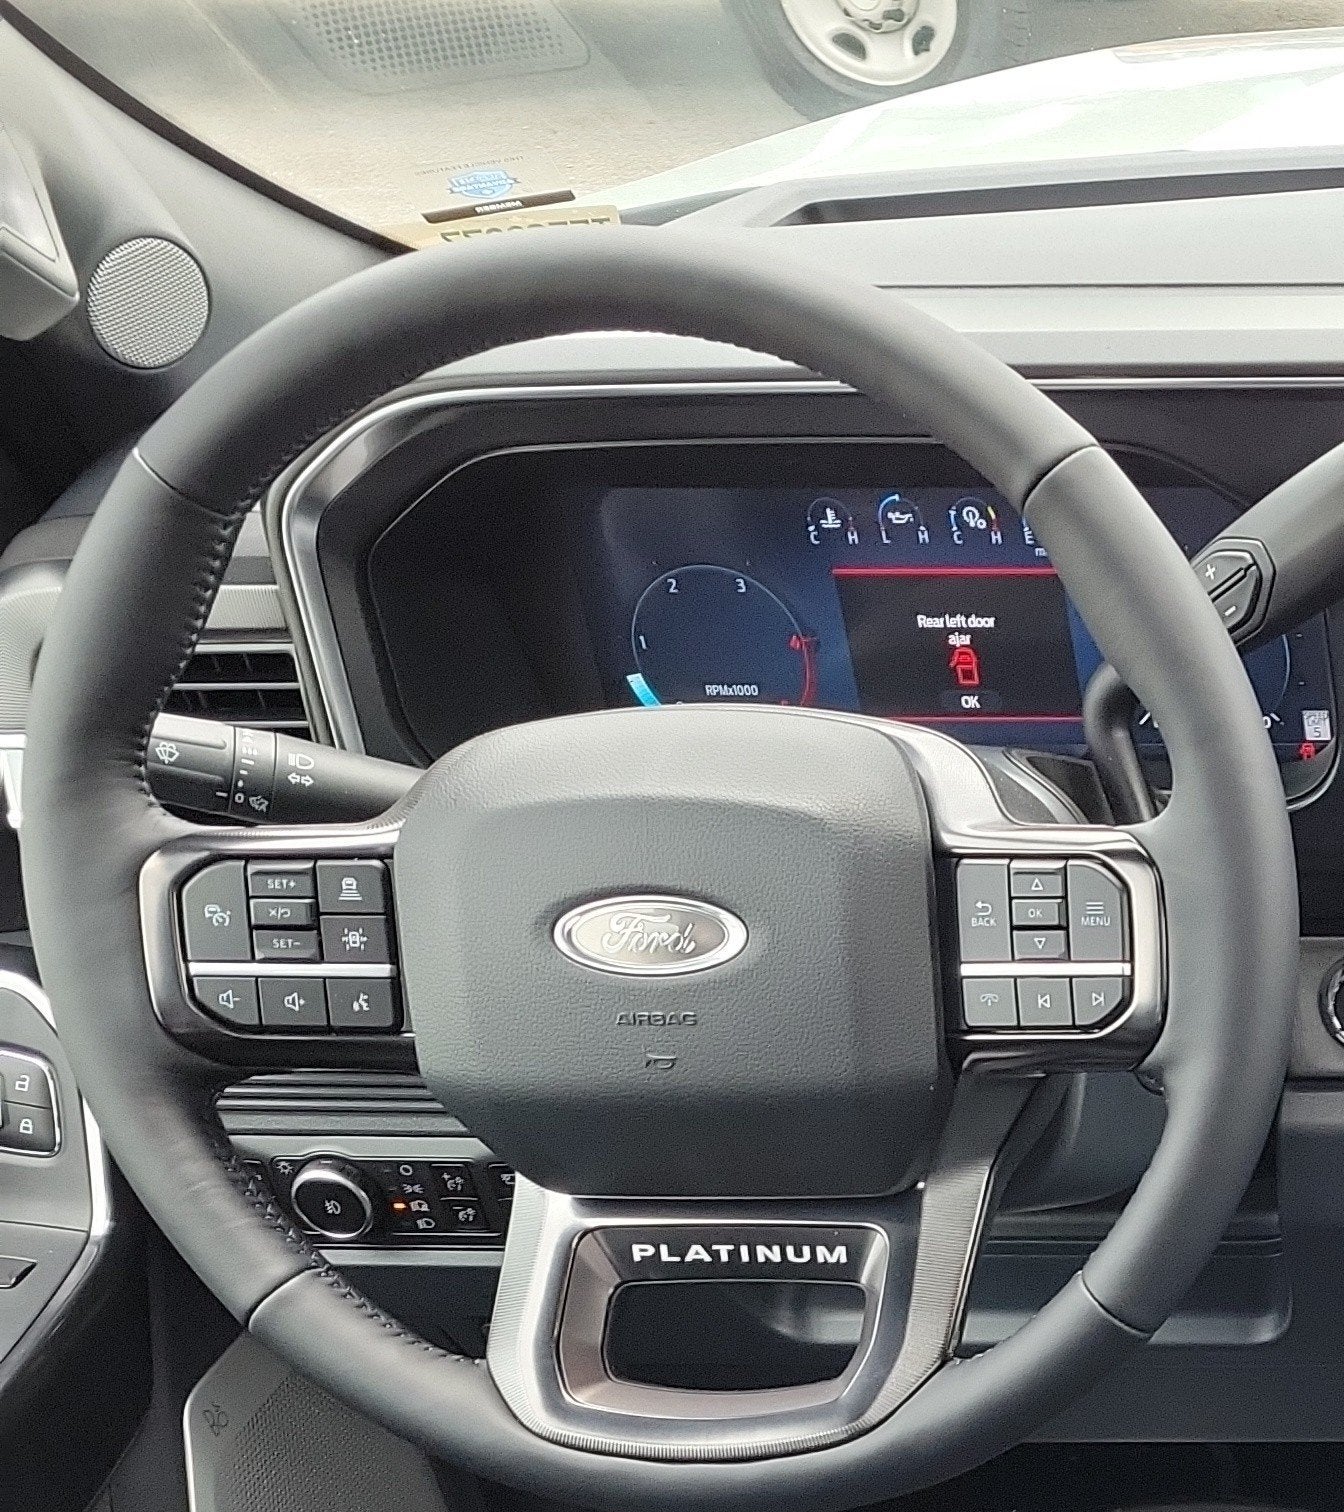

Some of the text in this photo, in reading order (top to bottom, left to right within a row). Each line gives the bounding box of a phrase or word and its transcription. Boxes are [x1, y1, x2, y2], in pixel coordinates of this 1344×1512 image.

[847, 531, 859, 544] H
[882, 531, 891, 544] L
[918, 531, 930, 544] H
[991, 531, 1003, 544] H
[667, 578, 679, 593] 2
[735, 578, 747, 593] 3
[917, 614, 996, 628] Rear left door
[639, 635, 647, 650] 1
[948, 632, 971, 647] ajar
[705, 684, 759, 697] RPMx1000
[960, 695, 981, 709] OK
[1313, 727, 1322, 738] 5
[1028, 909, 1042, 918] OK
[971, 918, 997, 927] BACK
[1082, 917, 1110, 926] MENU
[602, 911, 696, 955] Ford
[616, 1011, 697, 1027] AIRBAG
[632, 1243, 848, 1264] PLATINUM
